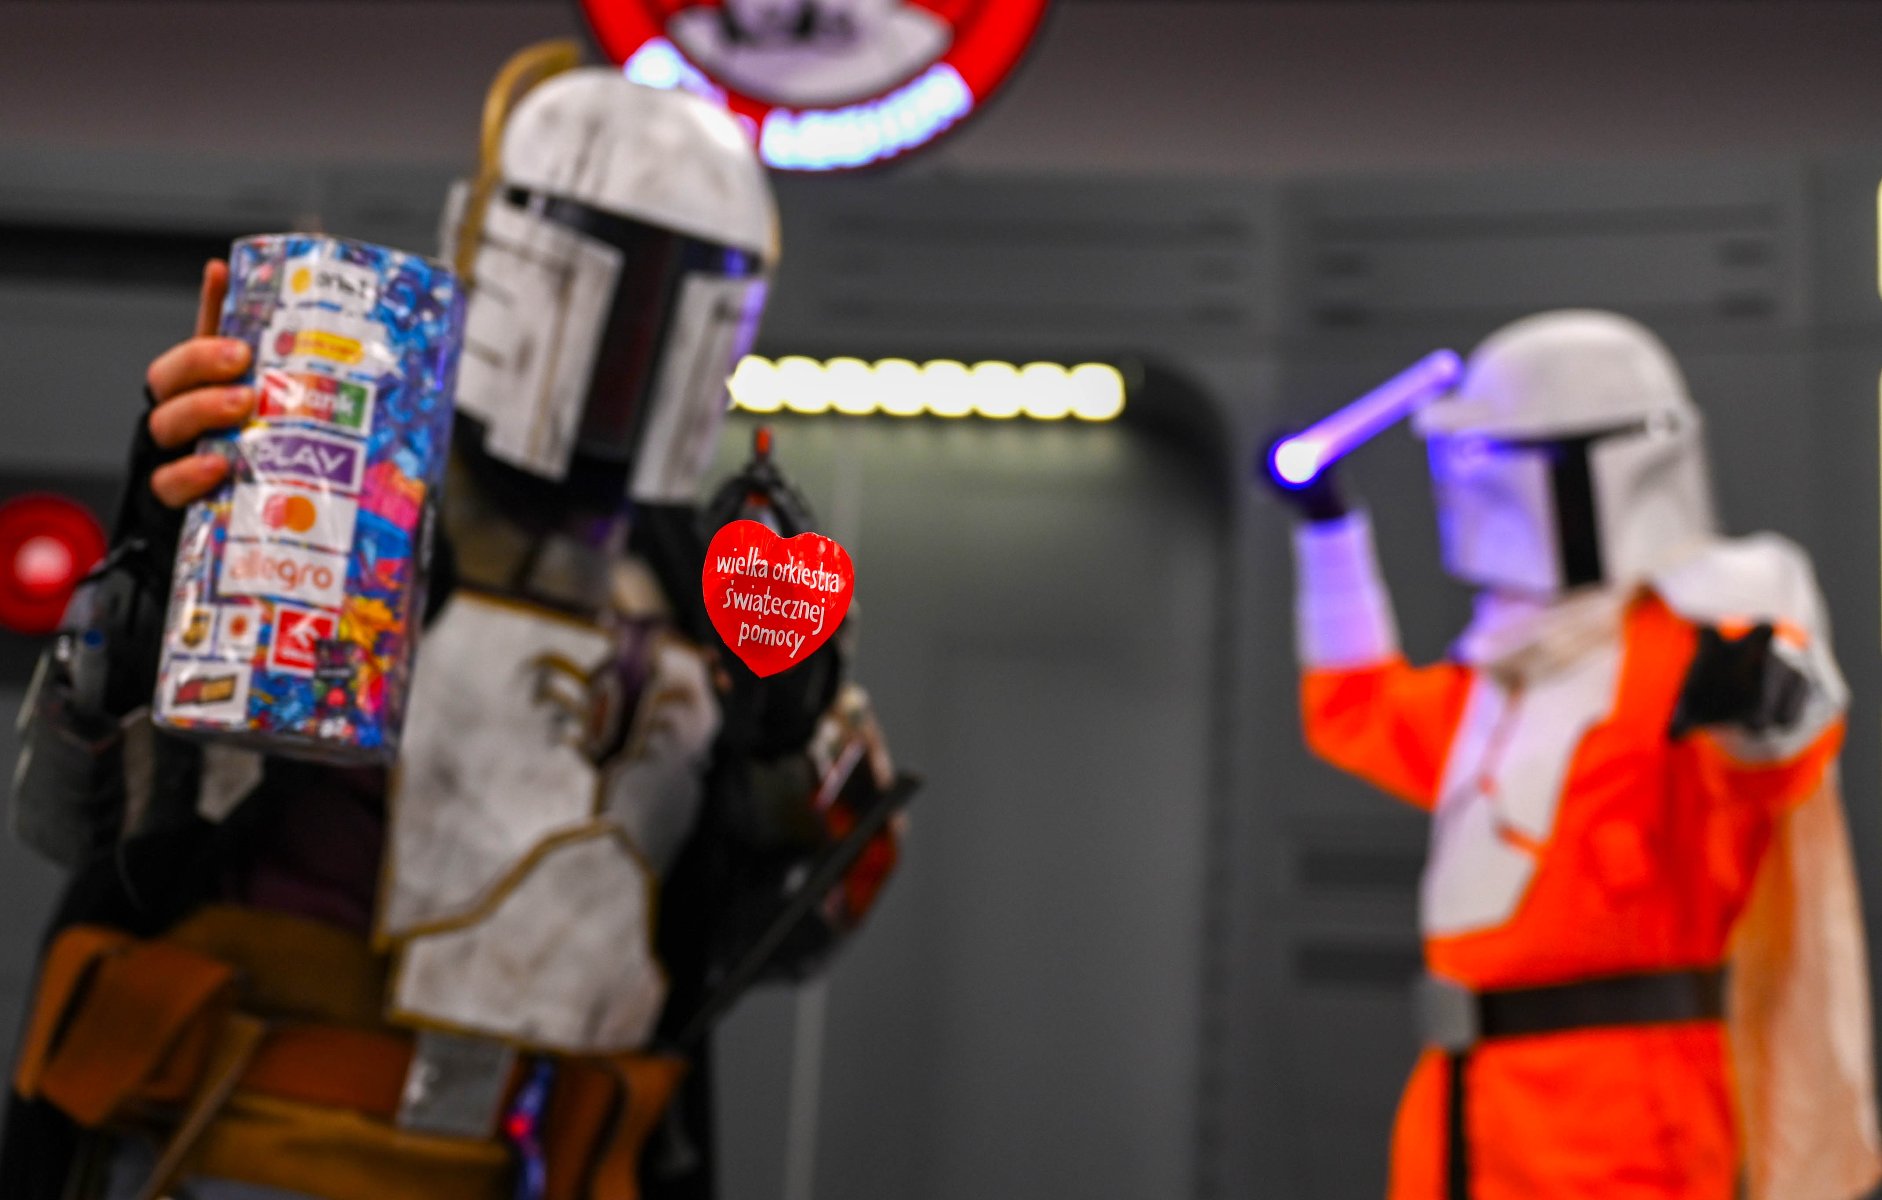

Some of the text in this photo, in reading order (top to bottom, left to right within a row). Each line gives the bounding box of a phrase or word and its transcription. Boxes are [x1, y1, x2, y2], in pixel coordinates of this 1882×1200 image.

[257, 441, 348, 474] PLAY
[716, 547, 840, 593] wielka orkiestra
[722, 579, 826, 636] świątecznej
[737, 621, 806, 659] pomocy
